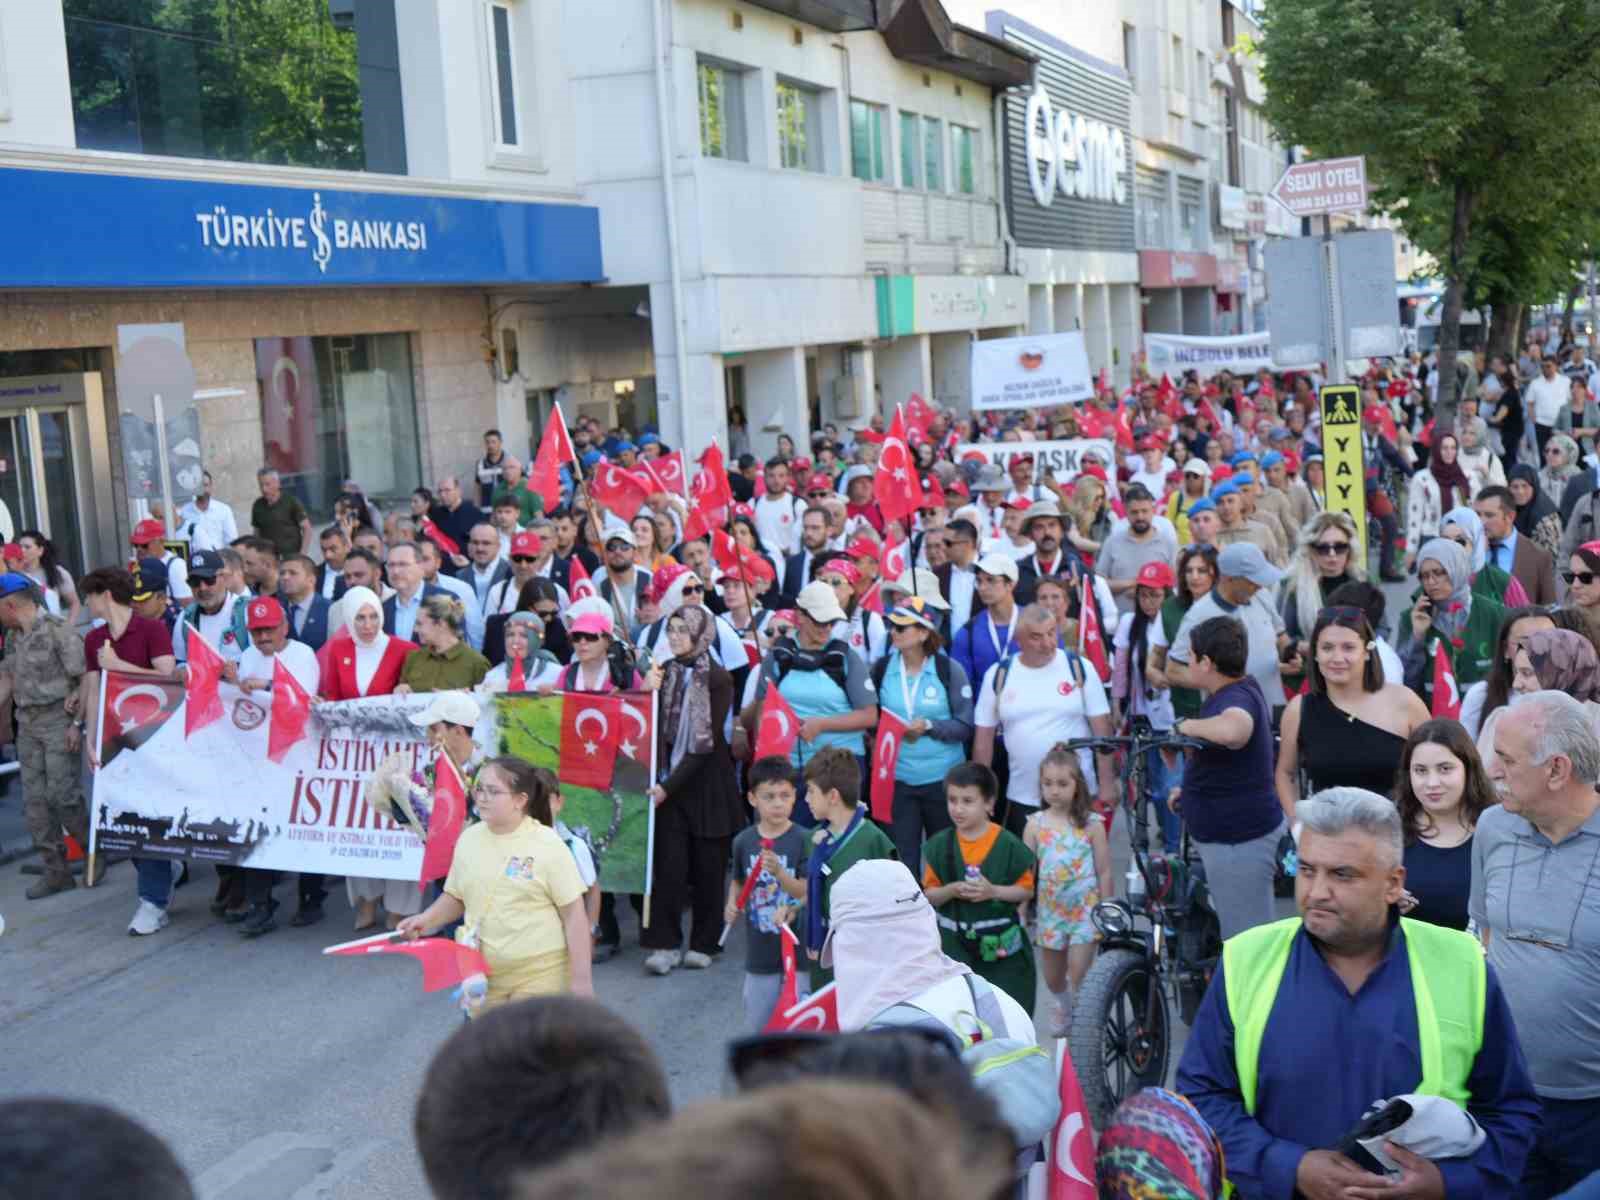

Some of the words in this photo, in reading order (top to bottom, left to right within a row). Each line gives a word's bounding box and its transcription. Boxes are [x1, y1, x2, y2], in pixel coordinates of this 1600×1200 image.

[1326, 167, 1361, 187] OTEL
[196, 206, 307, 247] TÜRKİYE
[333, 219, 427, 250] BANKASI
[1238, 344, 1269, 358] BELE
[993, 449, 1077, 476] KASK
[318, 735, 432, 772] İSTİKAE
